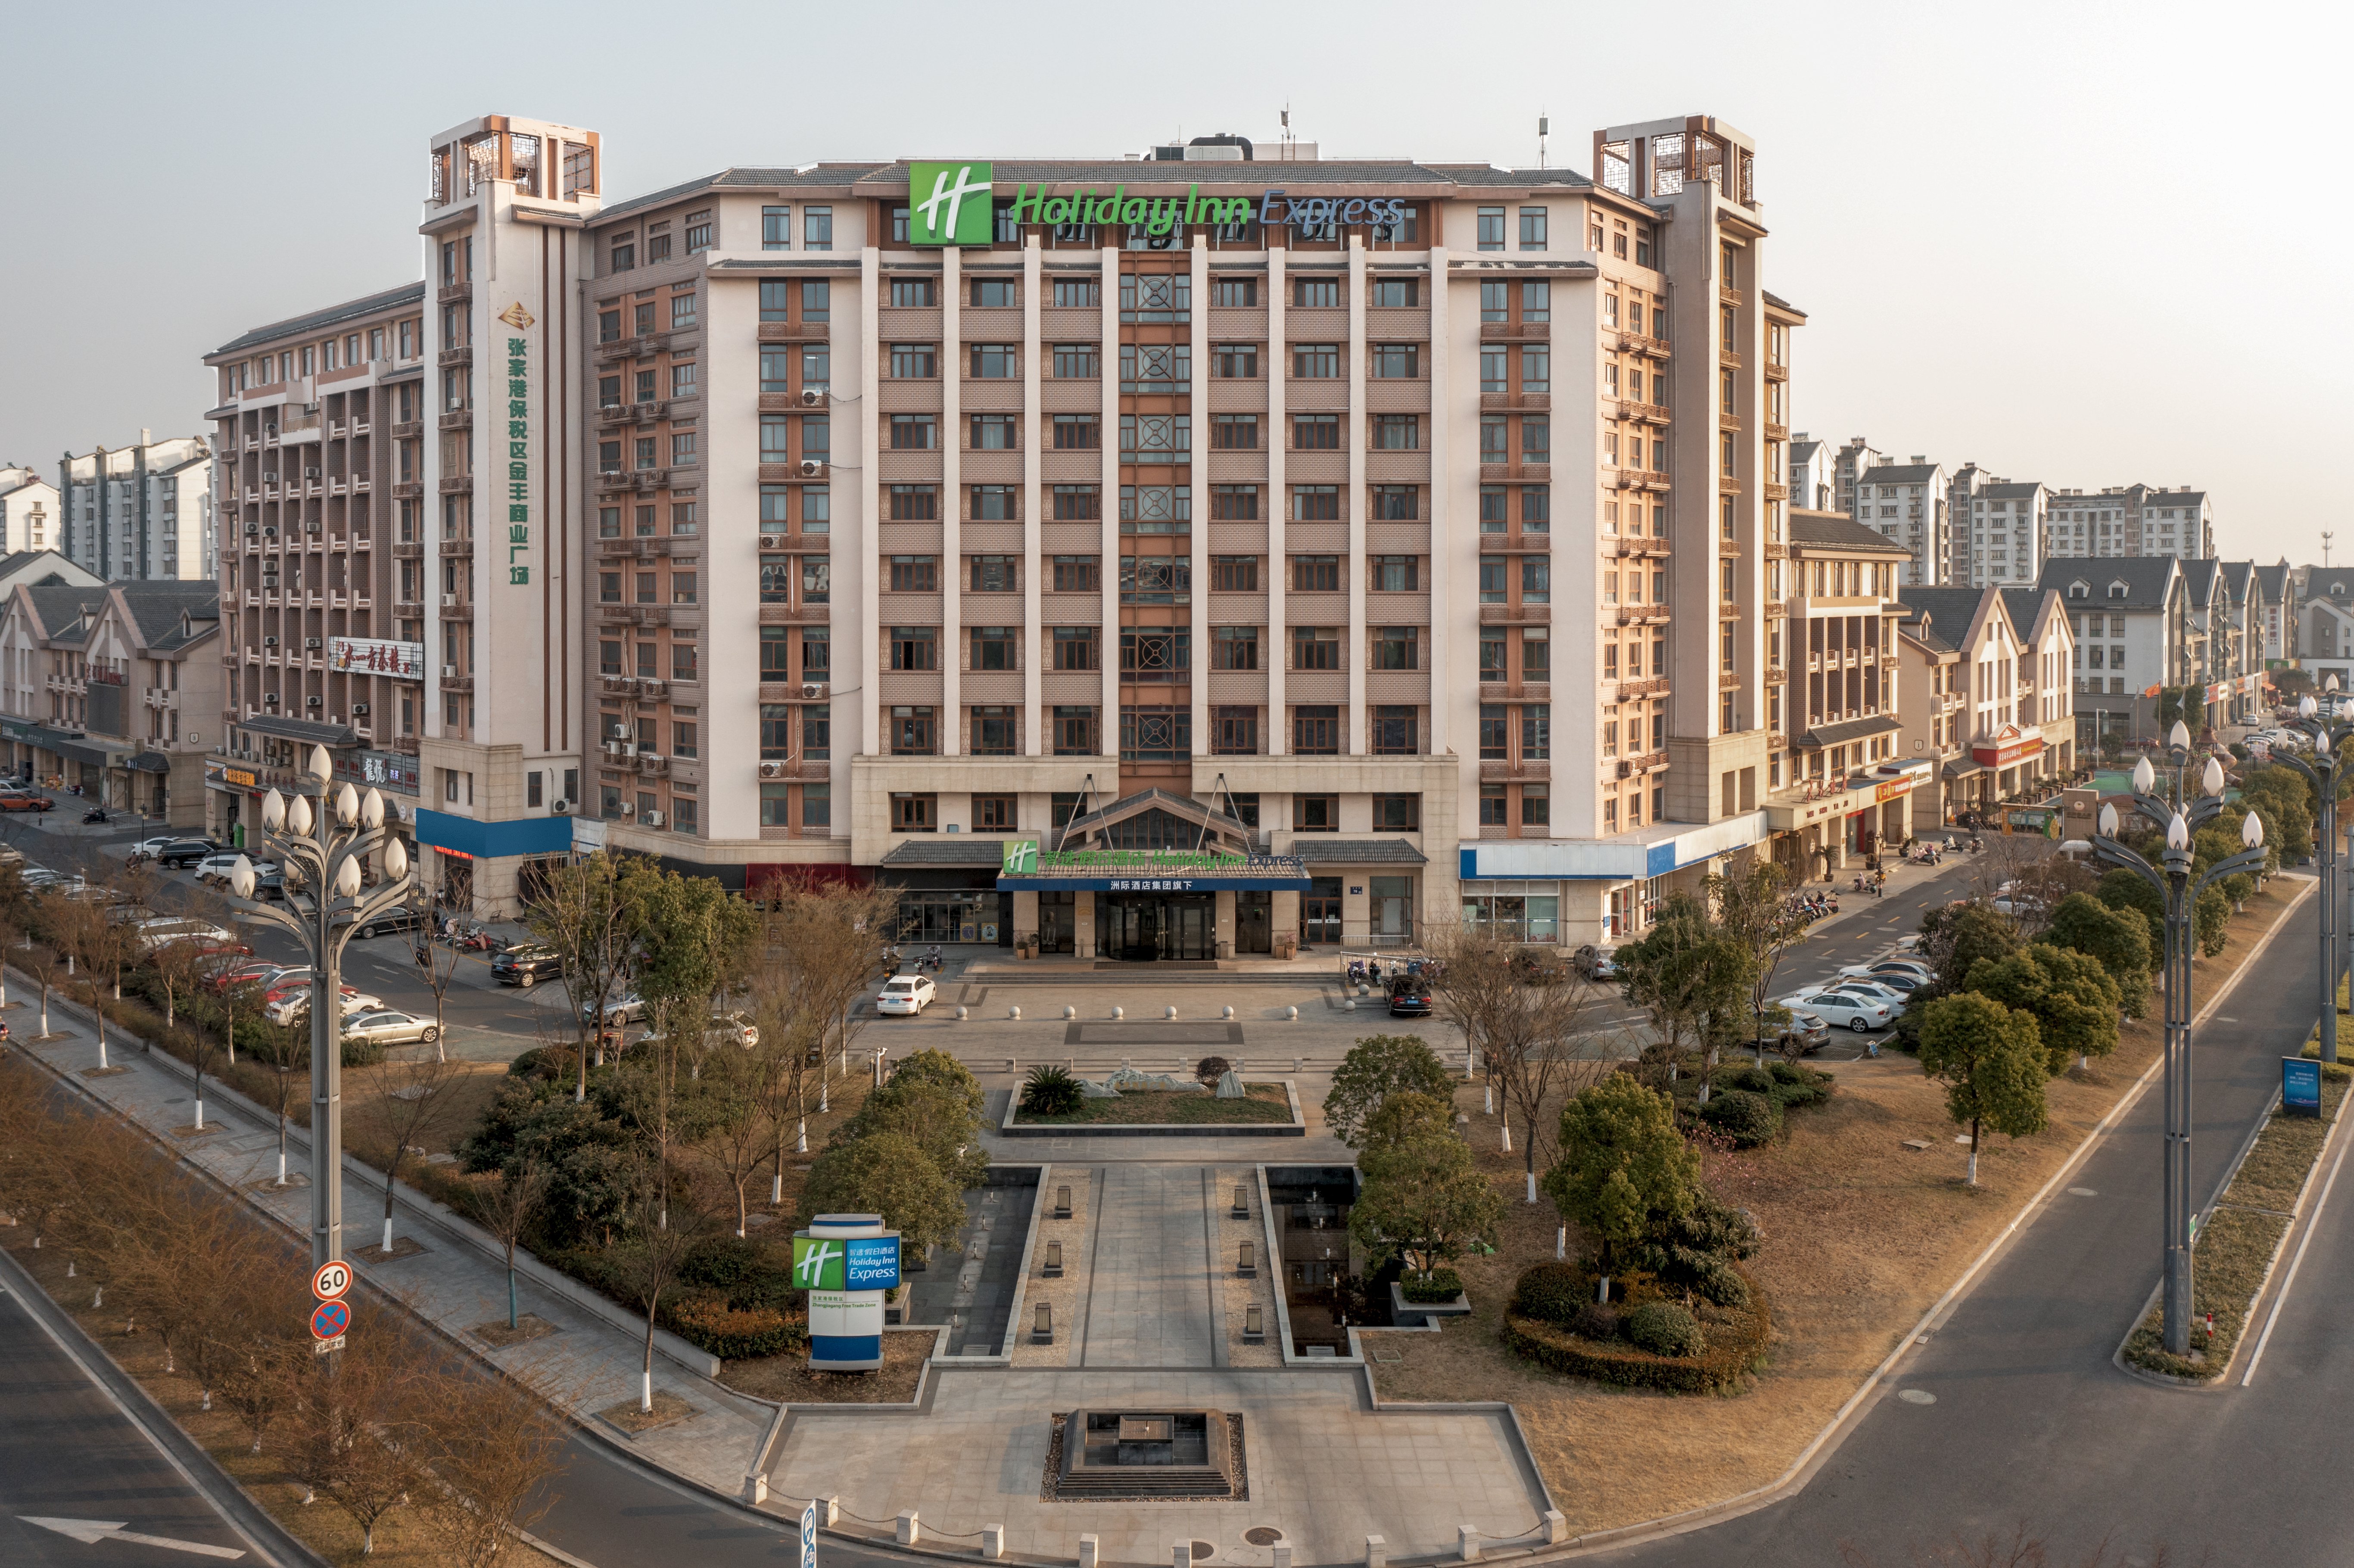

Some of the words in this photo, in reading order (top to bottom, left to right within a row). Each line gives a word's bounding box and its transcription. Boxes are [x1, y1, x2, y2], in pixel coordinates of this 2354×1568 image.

[1009, 184, 1177, 236] Holiday
[1186, 184, 1250, 226] Inn
[1259, 189, 1405, 235] Express
[508, 337, 529, 585] 张家港保税区金丰商业广场
[1044, 849, 1147, 867] 智选假日酒店
[1152, 849, 1217, 871] Holiday
[1221, 849, 1246, 866] Inn
[1247, 851, 1305, 870] Express
[1111, 880, 1193, 890] 洲际酒店集团旗下
[850, 1247, 895, 1256] 智选假日酒店
[849, 1257, 881, 1266] Holiday
[882, 1256, 896, 1264] Inn
[320, 1269, 344, 1291] 60
[849, 1268, 896, 1282] Express
